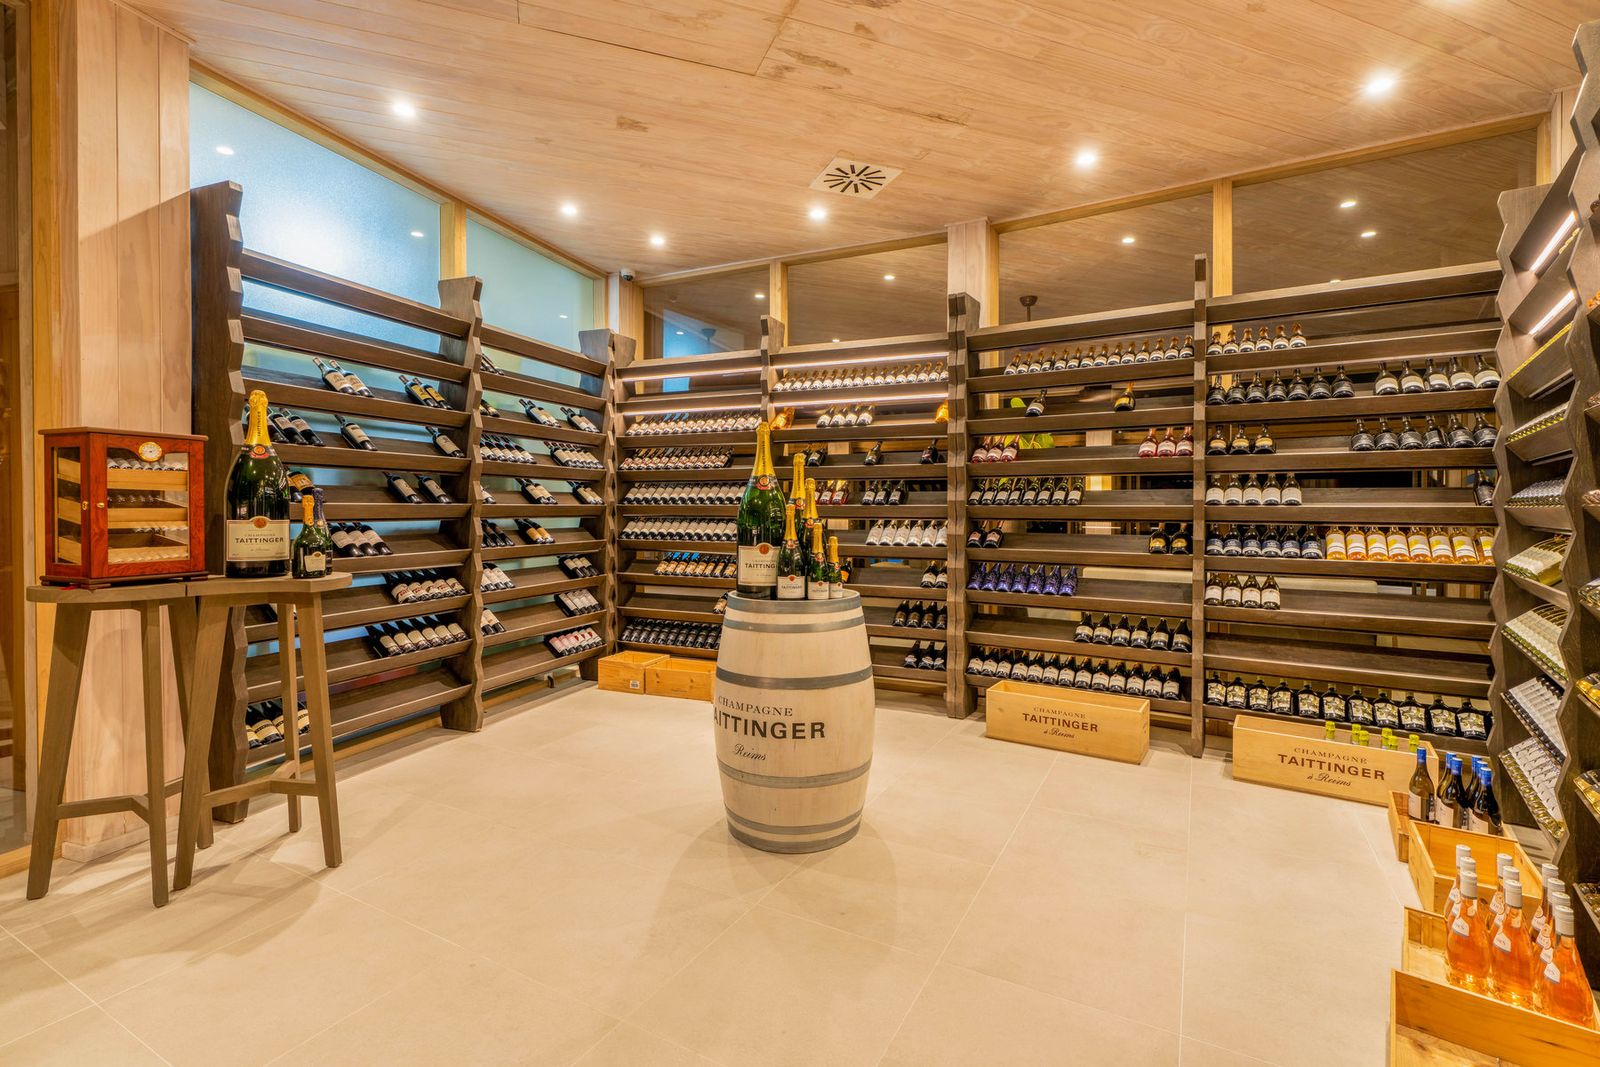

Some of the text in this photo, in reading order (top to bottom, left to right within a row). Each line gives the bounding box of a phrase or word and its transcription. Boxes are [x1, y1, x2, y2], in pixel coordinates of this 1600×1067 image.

[718, 695, 793, 717] CHAMPAGNE
[1033, 706, 1086, 719] CHAMPAGNE
[714, 706, 825, 740] AITTINGER
[1022, 712, 1099, 733] TAITTINGER
[733, 743, 767, 761] Reims
[1294, 747, 1368, 765] CHAMPAGNE
[1278, 753, 1385, 781] TAITTINGER
[1314, 772, 1352, 787] Reims
